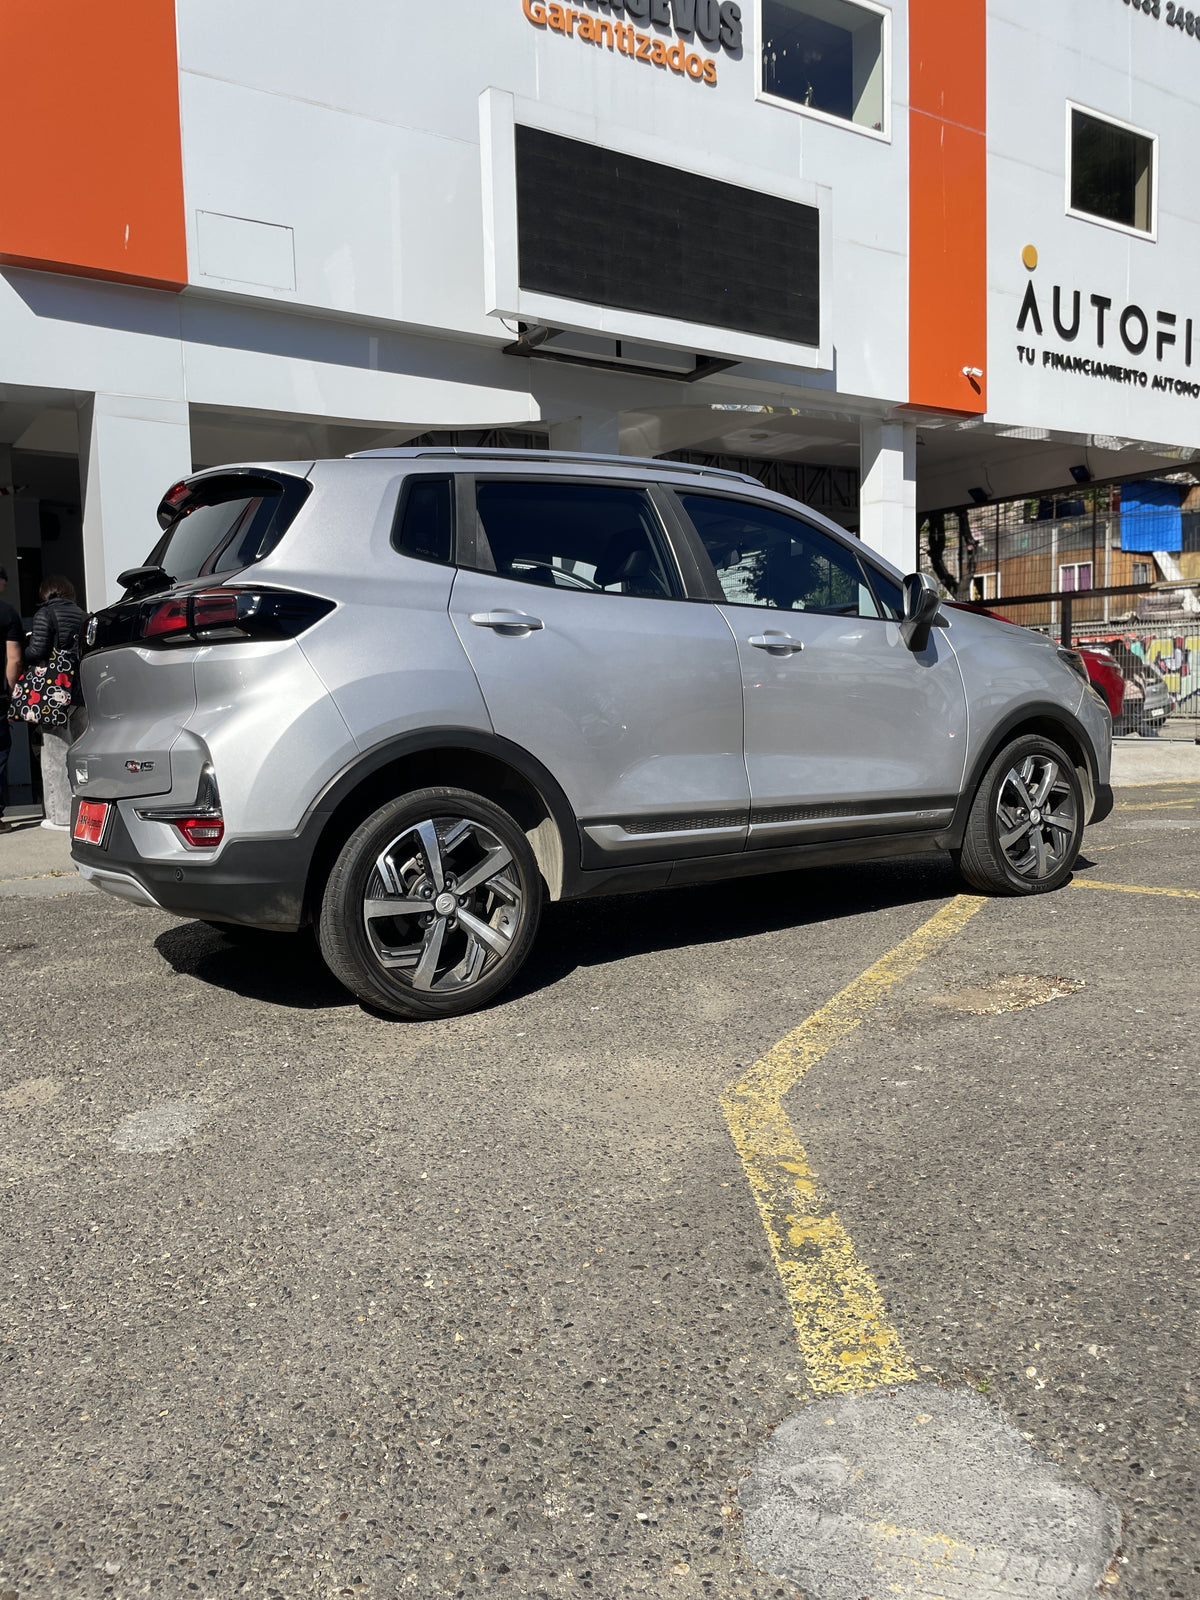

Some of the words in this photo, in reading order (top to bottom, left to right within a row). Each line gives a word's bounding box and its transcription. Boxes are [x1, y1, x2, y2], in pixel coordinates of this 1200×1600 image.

[522, 0, 717, 83] Garantizados
[1017, 345, 1035, 365] TU
[1042, 351, 1148, 388] FINANCIAMIENTO
[1151, 374, 1200, 399] AUTOMO
